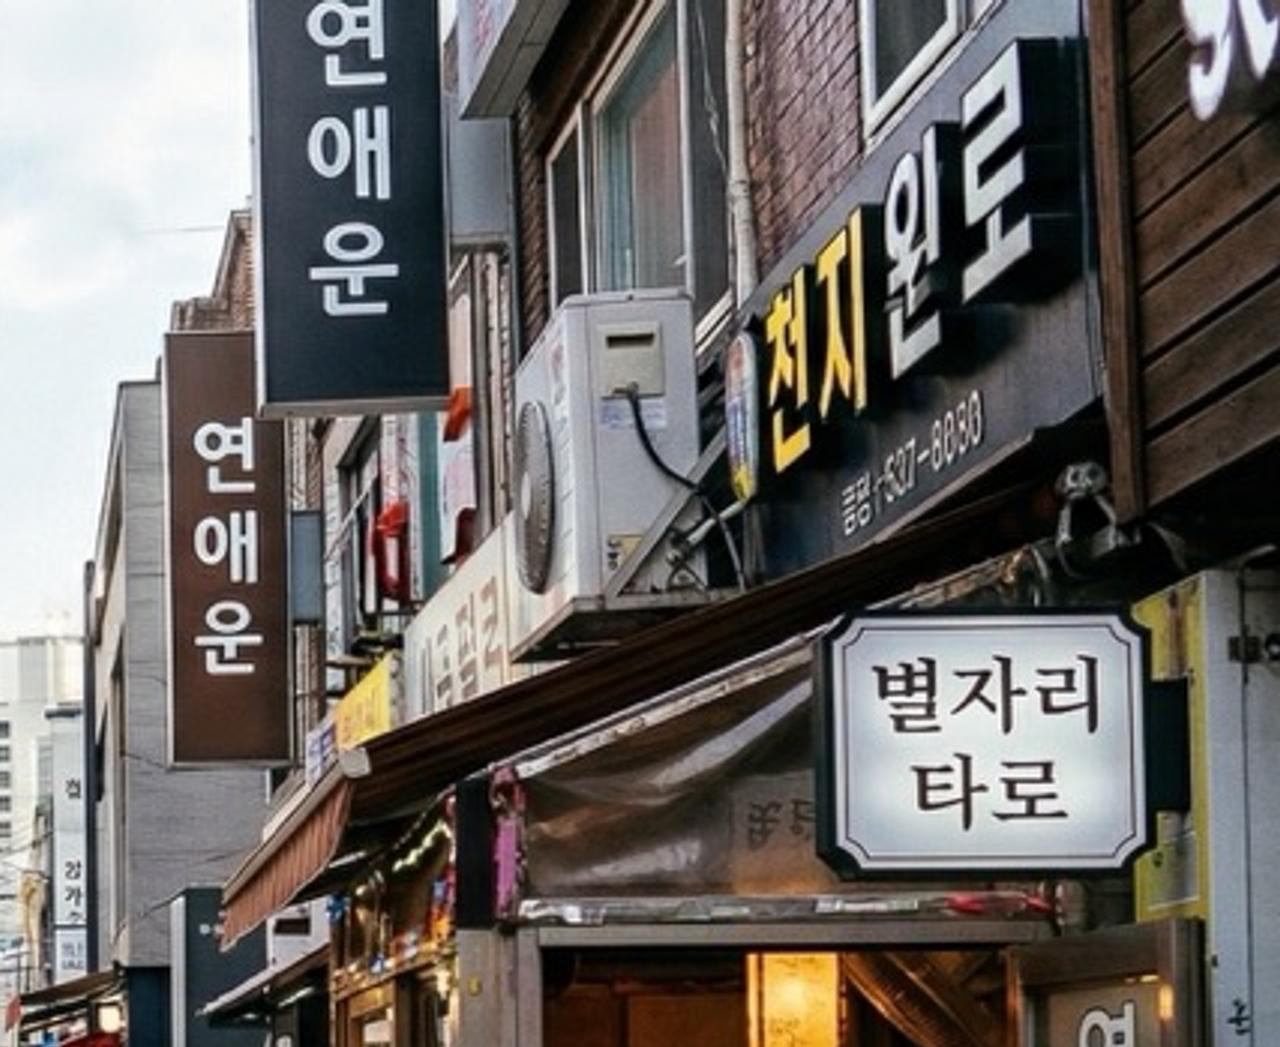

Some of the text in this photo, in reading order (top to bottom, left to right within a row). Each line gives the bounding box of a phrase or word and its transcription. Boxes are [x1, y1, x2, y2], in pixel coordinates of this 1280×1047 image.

[307, 0, 399, 316] 연애운
[193, 417, 263, 676] 연애운
[872, 654, 1099, 735] 별자리
[911, 752, 1068, 831] 타로
